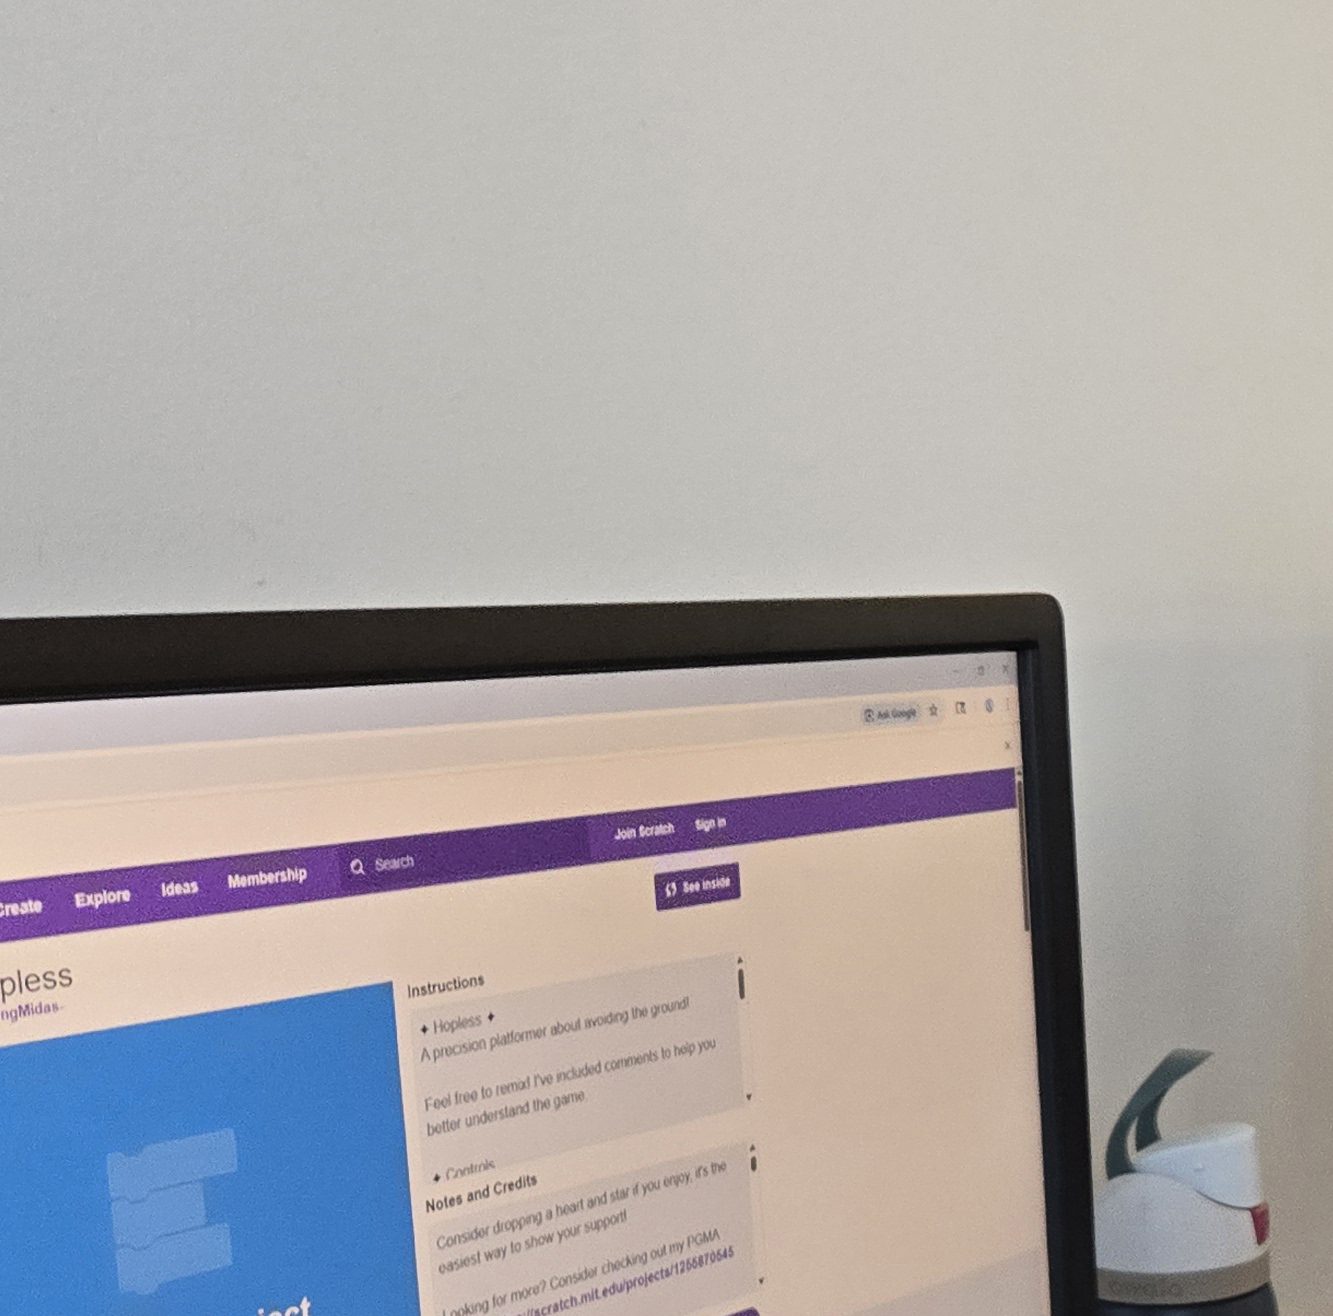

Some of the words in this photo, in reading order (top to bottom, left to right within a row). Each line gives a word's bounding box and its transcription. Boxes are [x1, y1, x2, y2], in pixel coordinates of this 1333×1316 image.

[74, 888, 131, 909] Explore
[161, 880, 199, 898] Ideas
[228, 866, 308, 889] Membership
[375, 854, 414, 872] Search
[614, 827, 637, 840] Join
[639, 822, 675, 838] Scratch
[407, 975, 485, 999] Instructions
[420, 1047, 431, 1062] A
[432, 1037, 487, 1062] precision
[489, 1026, 547, 1051] platformer
[550, 1017, 581, 1036] about
[584, 1010, 629, 1029] avoiding
[631, 1005, 648, 1019] the
[433, 1014, 482, 1034] Hopless
[424, 1093, 452, 1111] Feel
[454, 1089, 478, 1106] free
[481, 1086, 493, 1099] to
[556, 1060, 601, 1083] included
[604, 1049, 659, 1072] comments
[661, 1047, 671, 1060] to
[673, 1040, 696, 1057] help
[698, 1038, 717, 1055] you
[427, 1117, 461, 1137] better
[464, 1102, 530, 1128] understand
[532, 1097, 551, 1112] the
[426, 1193, 463, 1213] Notes
[466, 1184, 490, 1202] and
[493, 1174, 538, 1195] Credits
[436, 1224, 489, 1250] Consider
[492, 1211, 543, 1235] dropping
[555, 1198, 584, 1217] heart
[586, 1191, 608, 1209] and
[609, 1186, 630, 1203] star
[641, 1180, 661, 1197] you
[711, 1161, 727, 1173] the
[438, 1251, 481, 1275] easiest
[484, 1245, 508, 1262] way
[510, 1241, 522, 1254] to
[524, 1231, 555, 1250] show
[556, 1223, 582, 1245] your
[492, 1293, 508, 1308] for
[510, 1279, 547, 1302] more?
[549, 1265, 598, 1290] Consider
[601, 1251, 648, 1275] checking
[650, 1243, 667, 1260] out
[669, 1240, 685, 1254] my
